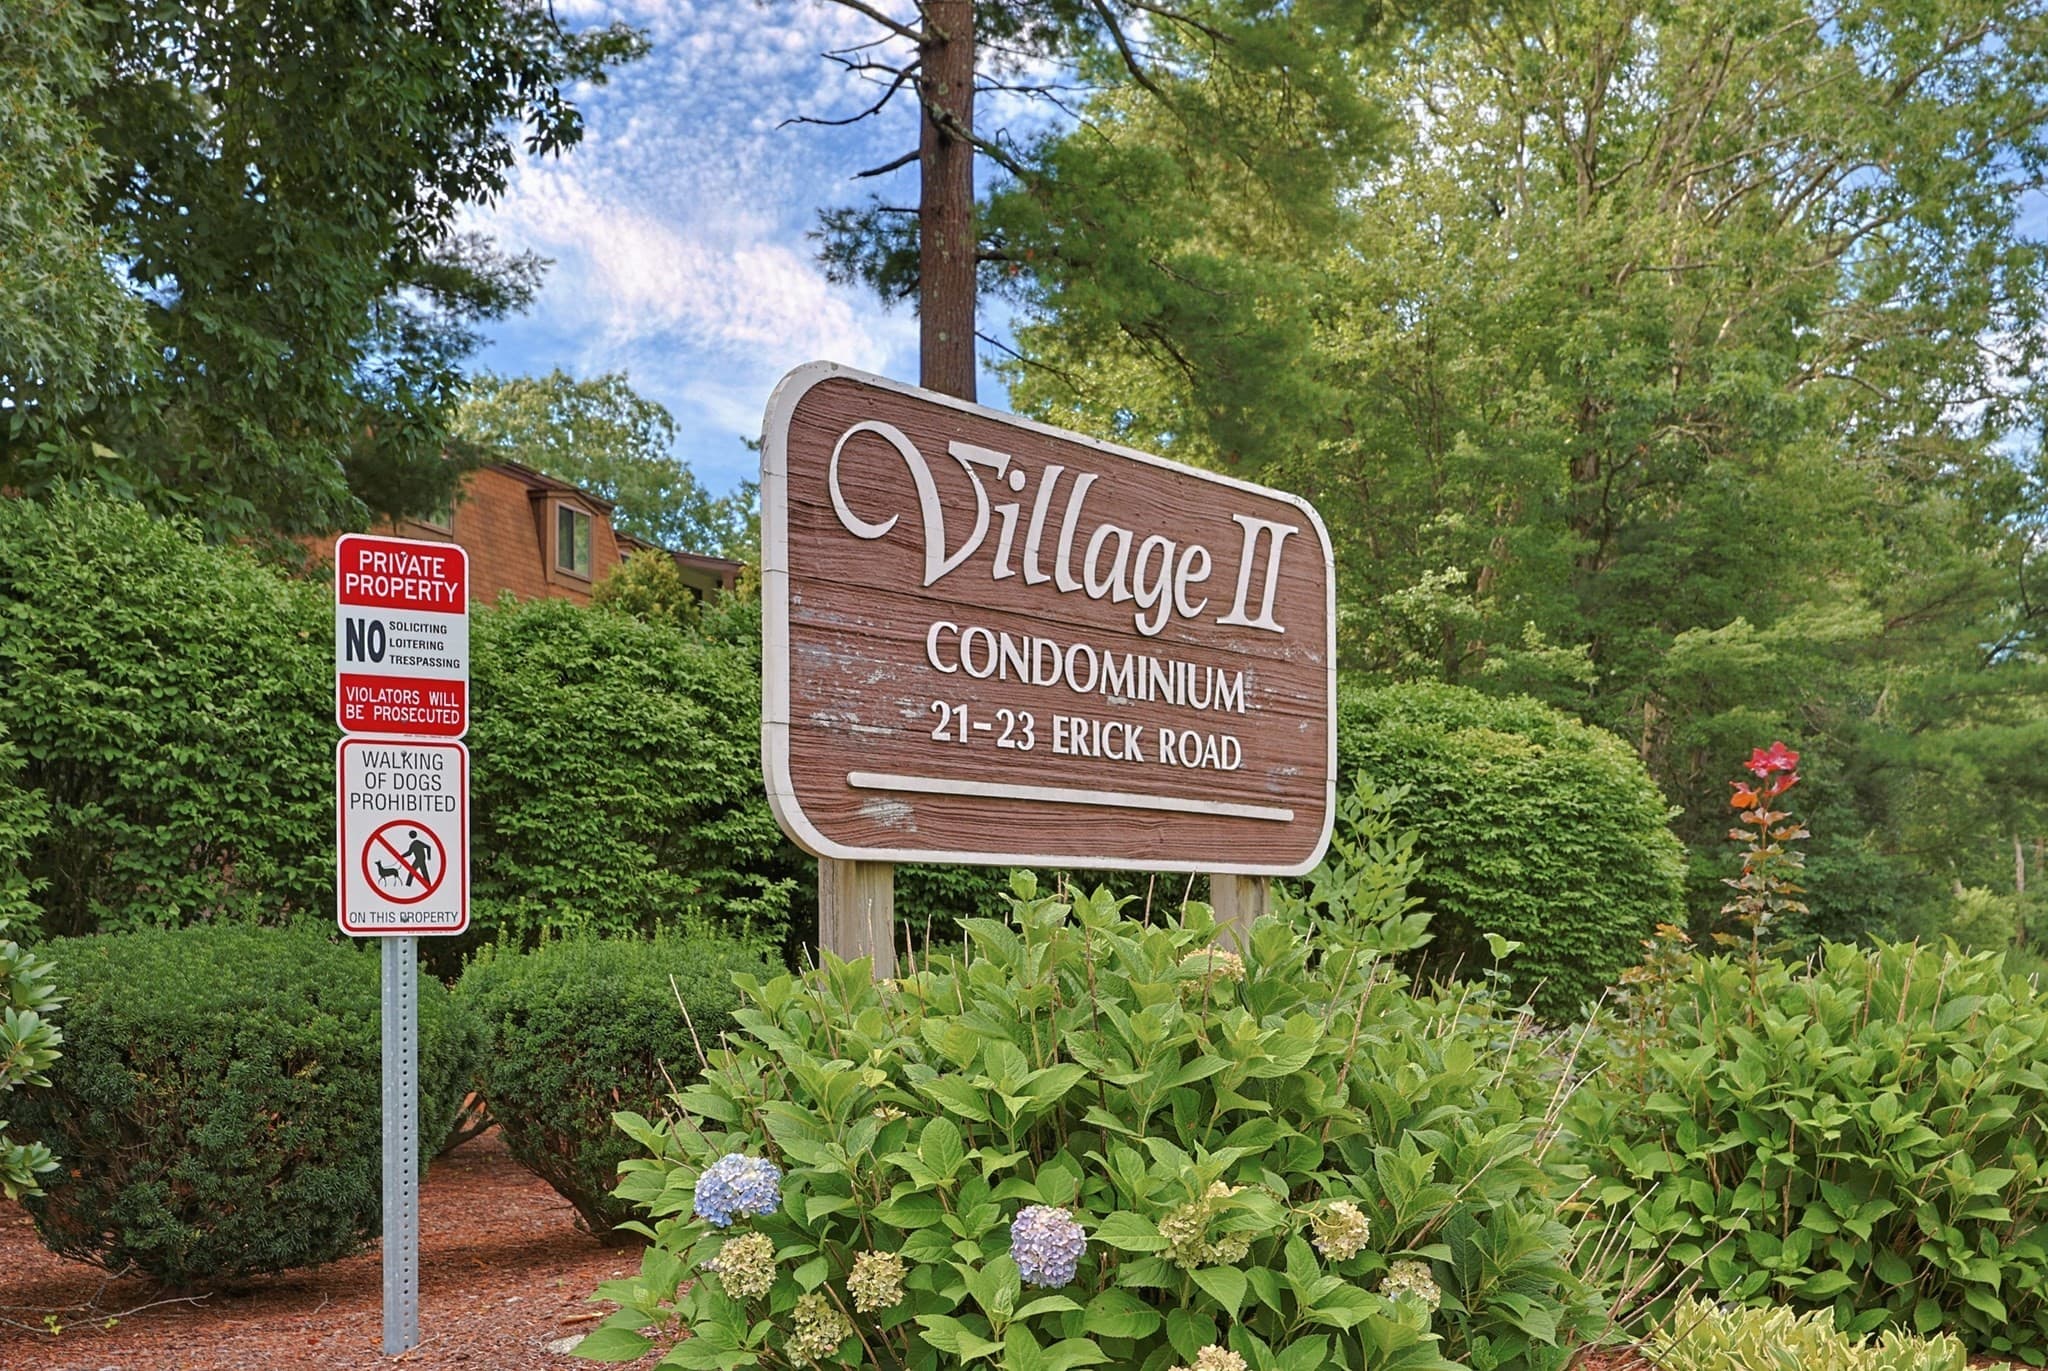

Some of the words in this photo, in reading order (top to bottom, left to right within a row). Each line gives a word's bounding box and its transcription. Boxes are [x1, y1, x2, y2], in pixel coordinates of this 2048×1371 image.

[828, 420, 1213, 637] Village
[359, 550, 446, 579] PRIVATE
[345, 572, 459, 603] PROPERTY
[389, 620, 448, 635] SOLICITING
[345, 617, 387, 663] NO
[389, 637, 445, 652] LOITERING
[389, 654, 461, 669] TRESPASSING
[926, 620, 1246, 715] CONDOMINIUM
[345, 686, 421, 705] VIOLATORS
[428, 690, 460, 708] WILL
[345, 703, 365, 720] BE
[373, 705, 461, 725] PROSECUTED
[930, 701, 1036, 751] 21-23
[1052, 715, 1144, 764] ERICK
[1159, 728, 1243, 772] ROAD
[361, 750, 444, 771] WALKING
[364, 771, 387, 790] OF
[393, 772, 442, 792] DOGS
[350, 792, 457, 813] PROHIBITED
[349, 911, 366, 924] ON
[369, 911, 396, 924] THIS
